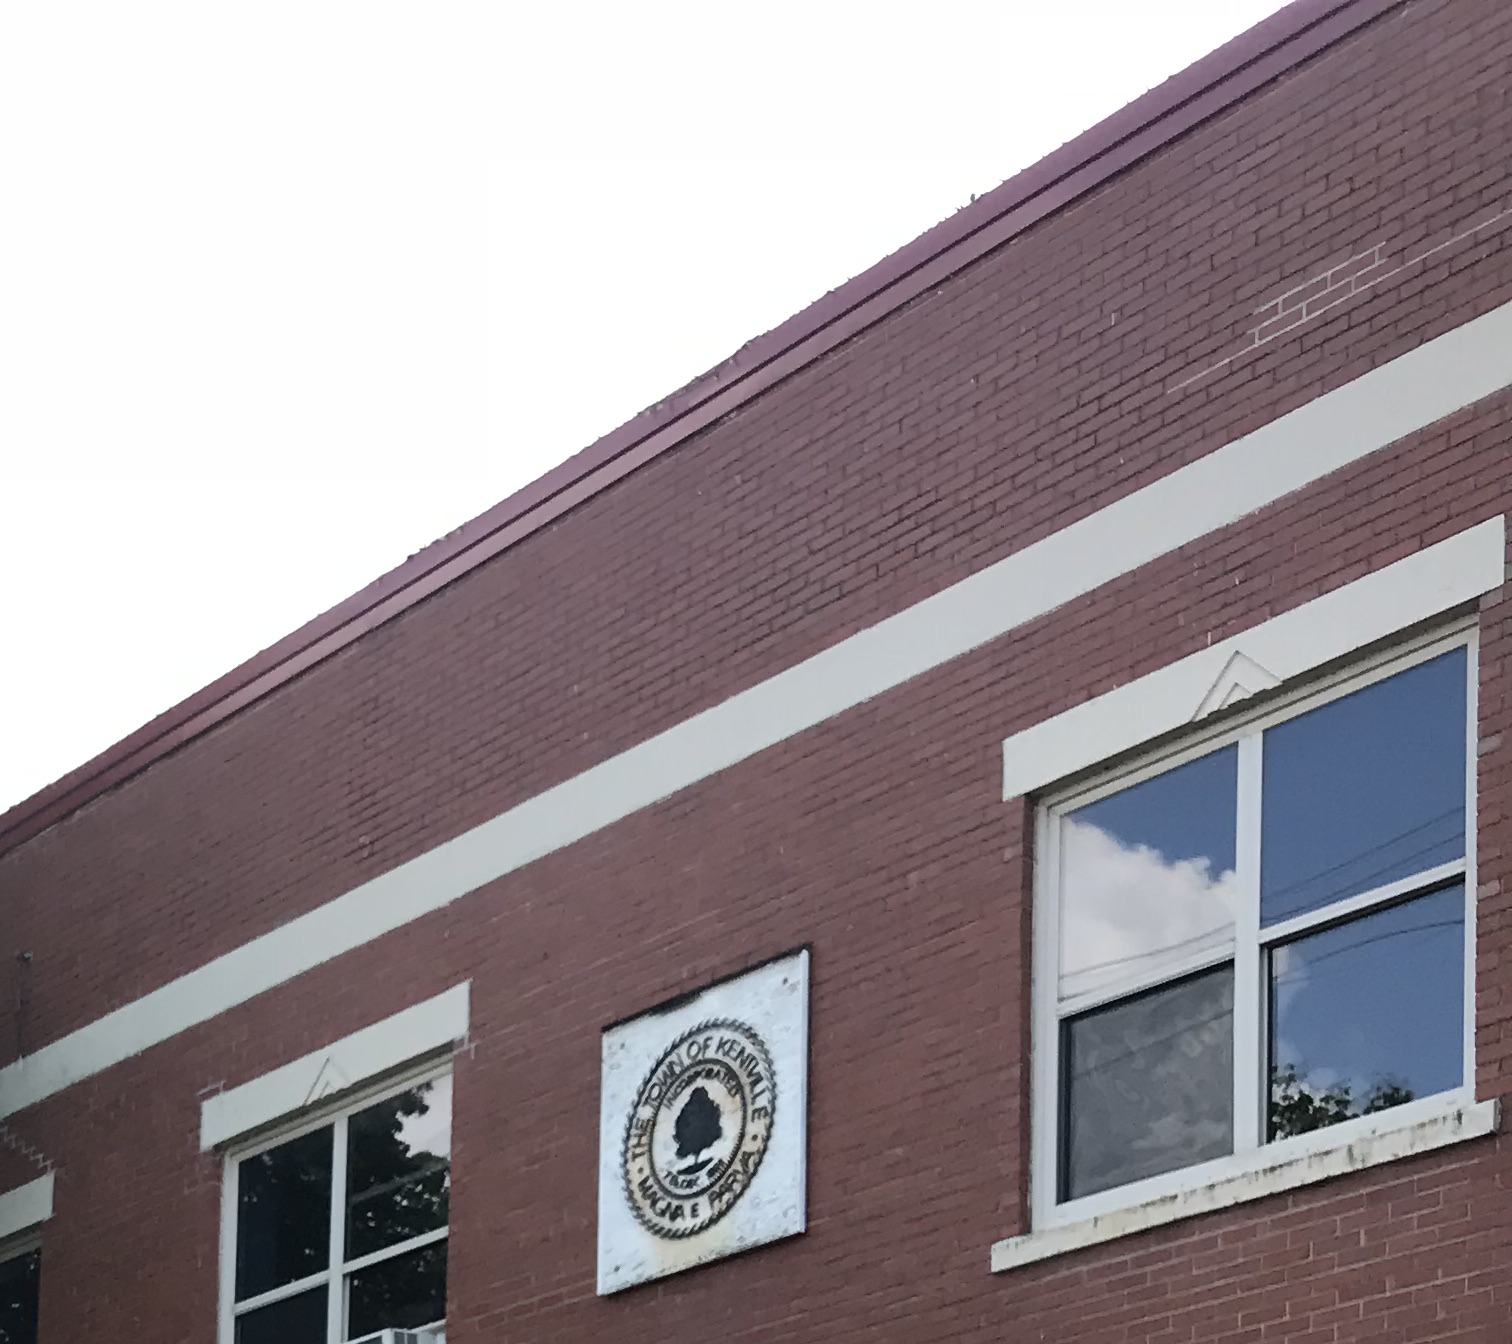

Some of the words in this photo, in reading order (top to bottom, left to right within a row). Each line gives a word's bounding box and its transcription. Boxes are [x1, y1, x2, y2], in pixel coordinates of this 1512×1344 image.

[687, 1036, 713, 1061] OF
[642, 1053, 685, 1109] TOWN
[716, 1036, 769, 1123] KENTVILLE
[632, 1118, 653, 1162] THE
